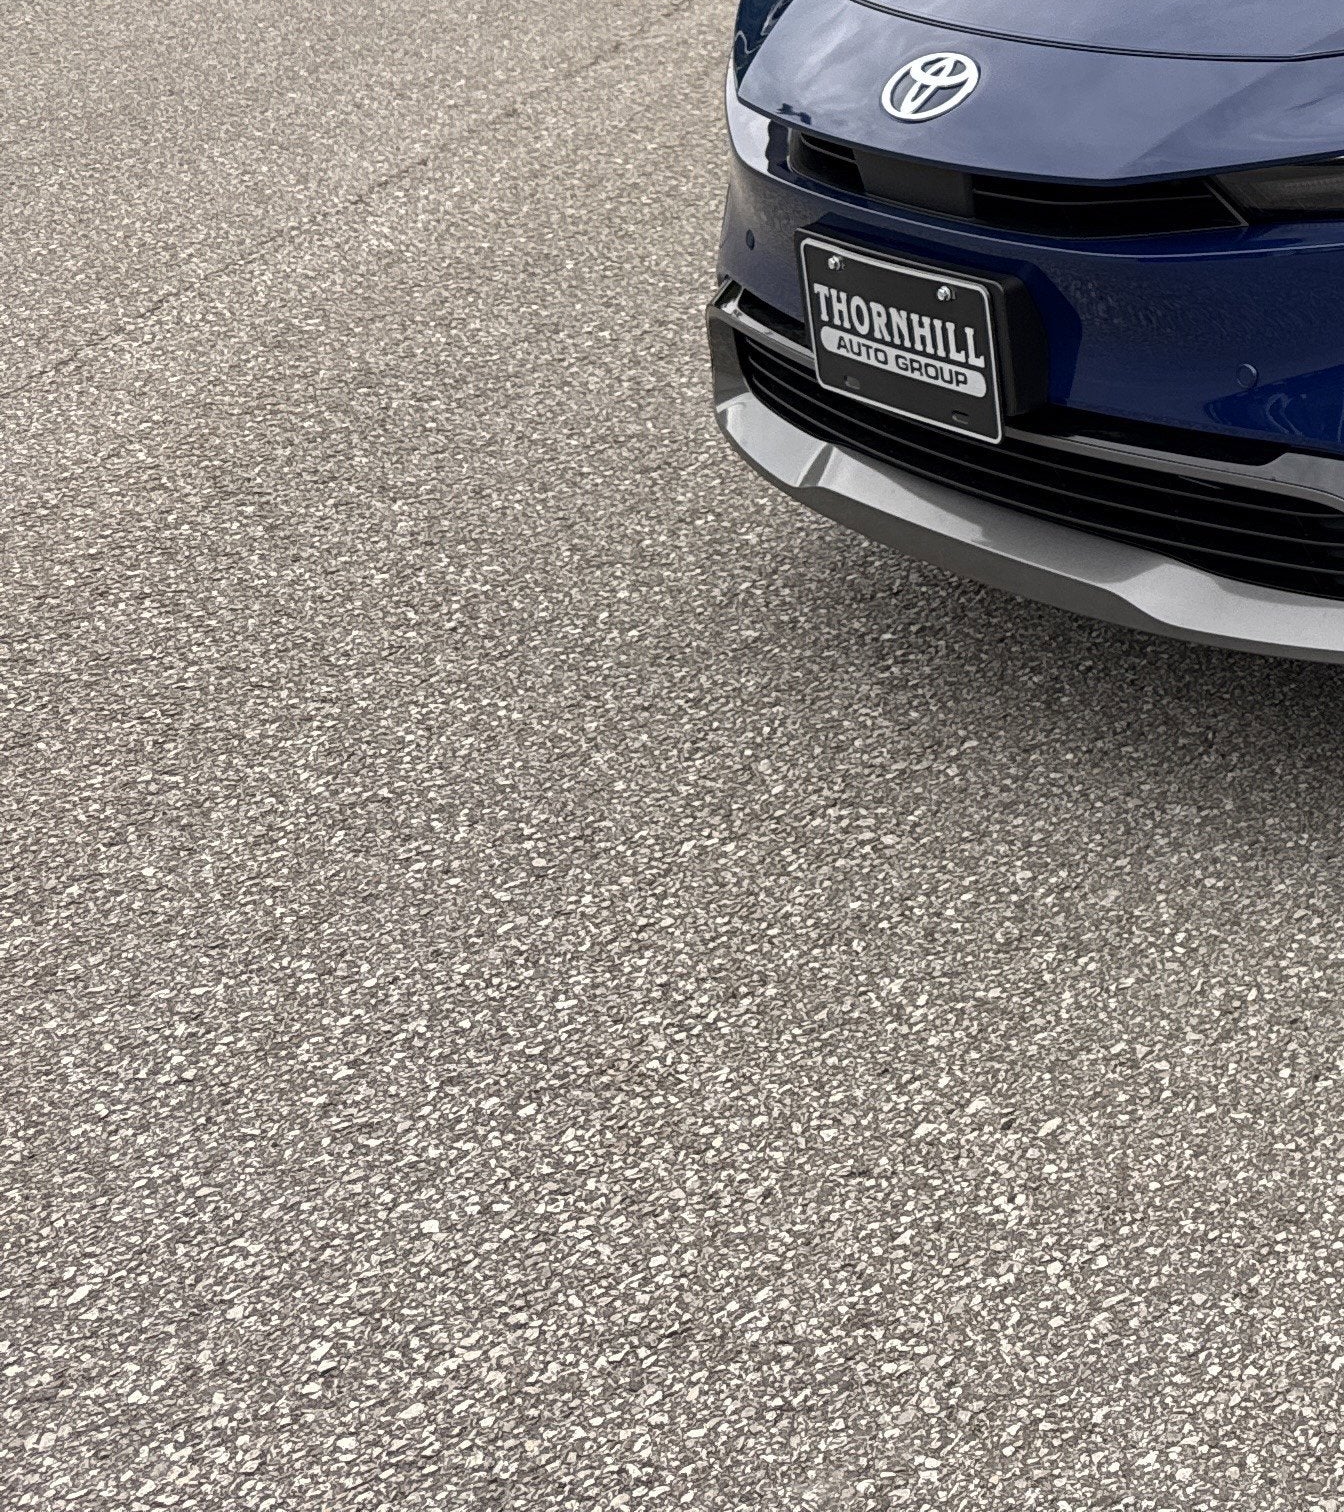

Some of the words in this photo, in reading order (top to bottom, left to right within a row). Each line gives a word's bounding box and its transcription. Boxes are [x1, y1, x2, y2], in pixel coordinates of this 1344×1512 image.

[813, 282, 985, 368] THORNHILL
[836, 335, 889, 366] AUTO
[895, 355, 968, 387] GROUP
